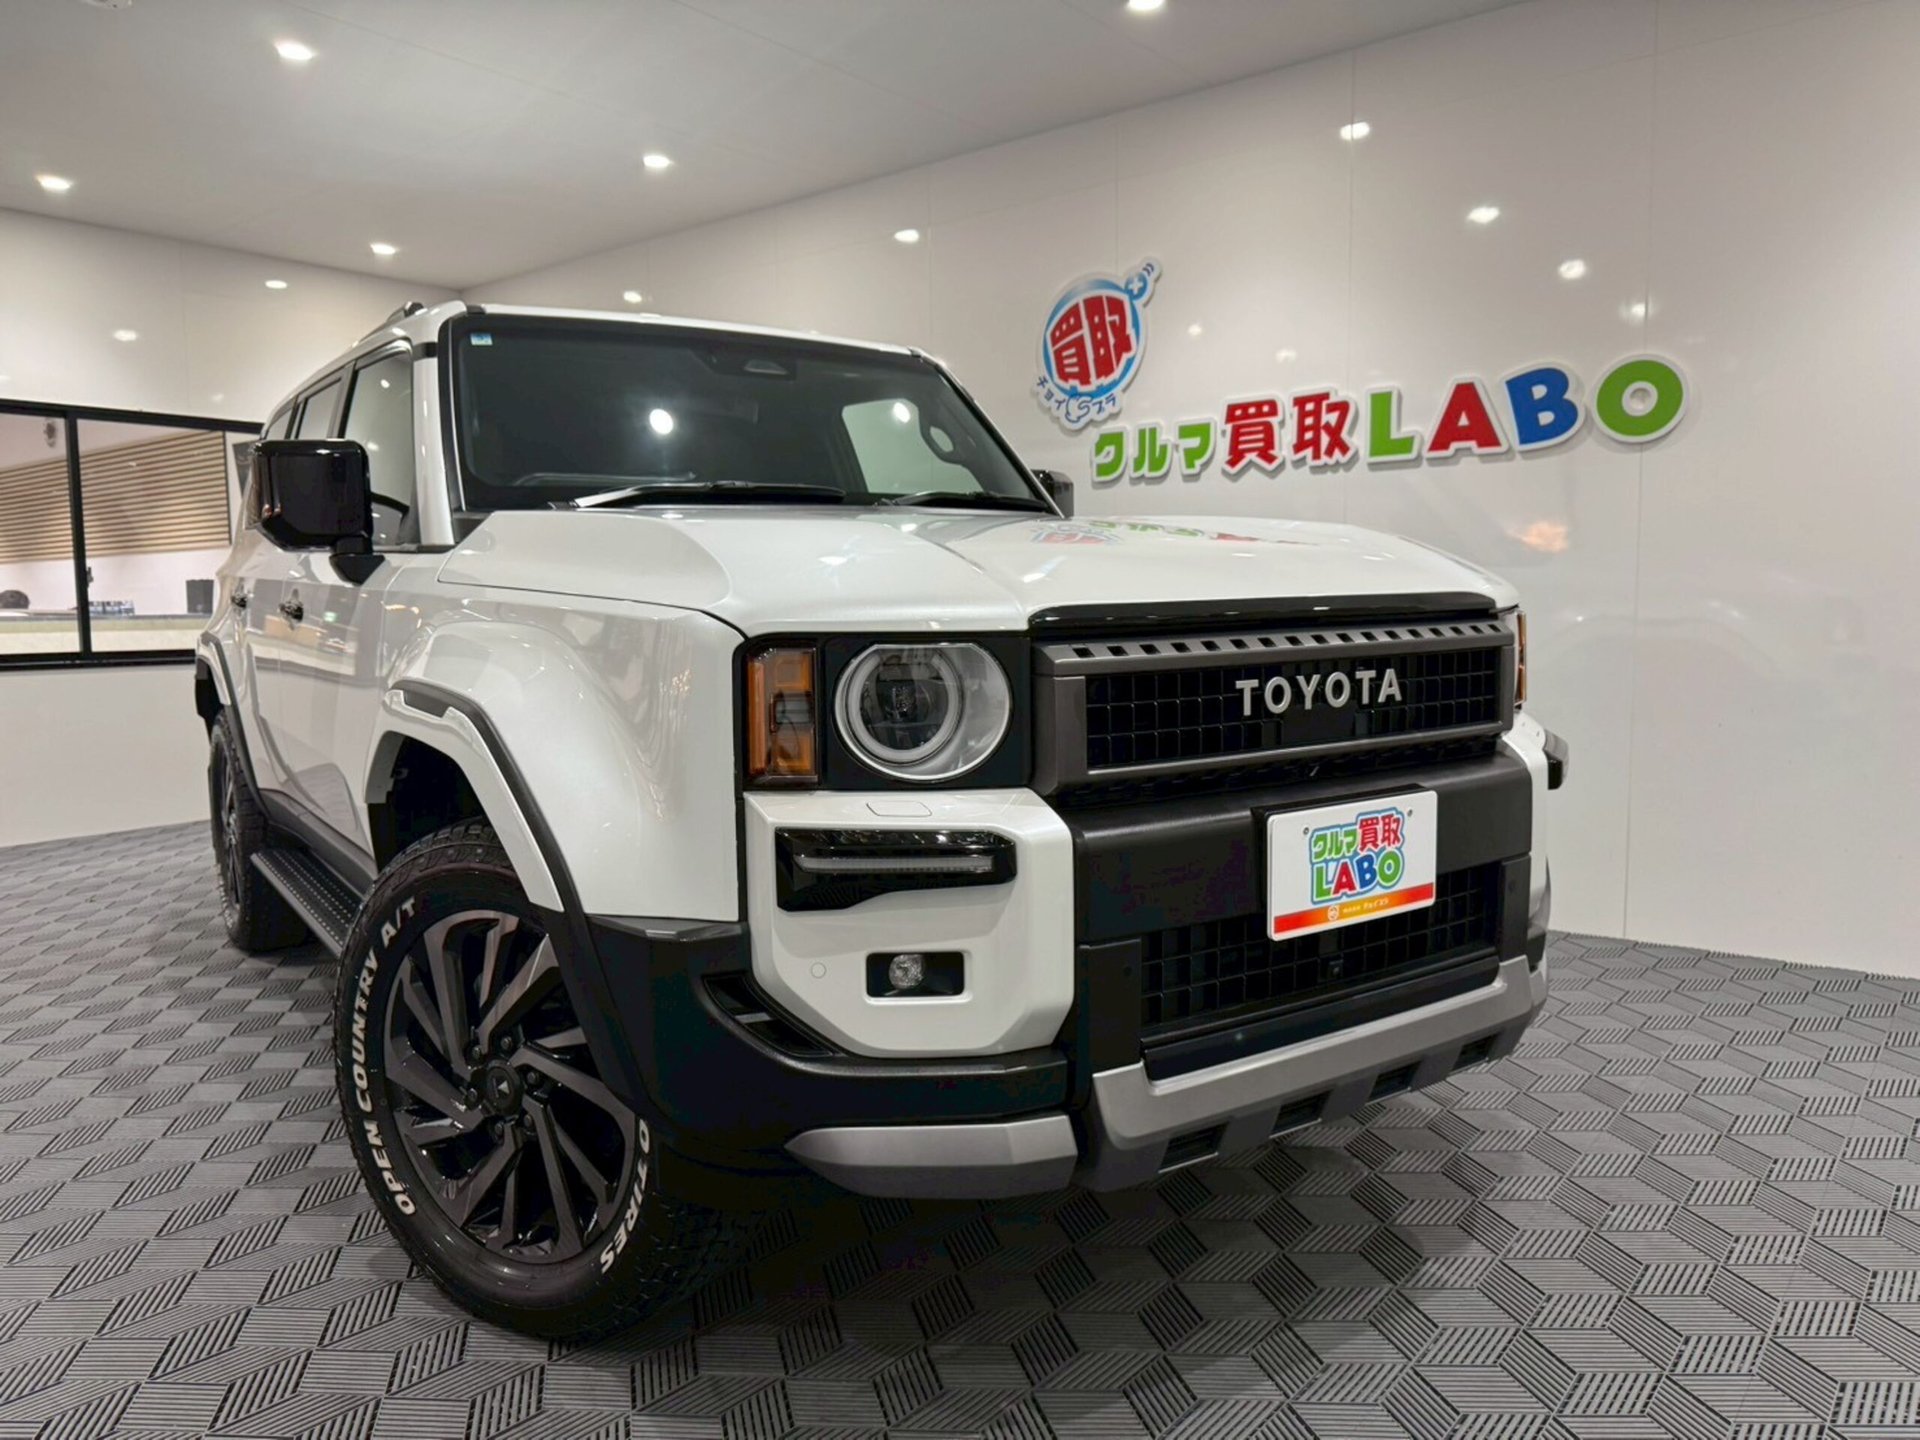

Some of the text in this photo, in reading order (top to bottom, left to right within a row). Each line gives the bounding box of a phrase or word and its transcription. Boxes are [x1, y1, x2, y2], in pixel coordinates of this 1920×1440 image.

[1049, 294, 1133, 386] 買取
[1235, 668, 1402, 716] TOYOTA
[1313, 813, 1402, 862] クルマ買取
[1315, 850, 1403, 899] LABO
[352, 896, 416, 1215] OPEN COUNTRY A/T
[600, 1158, 648, 1274] TIRES
